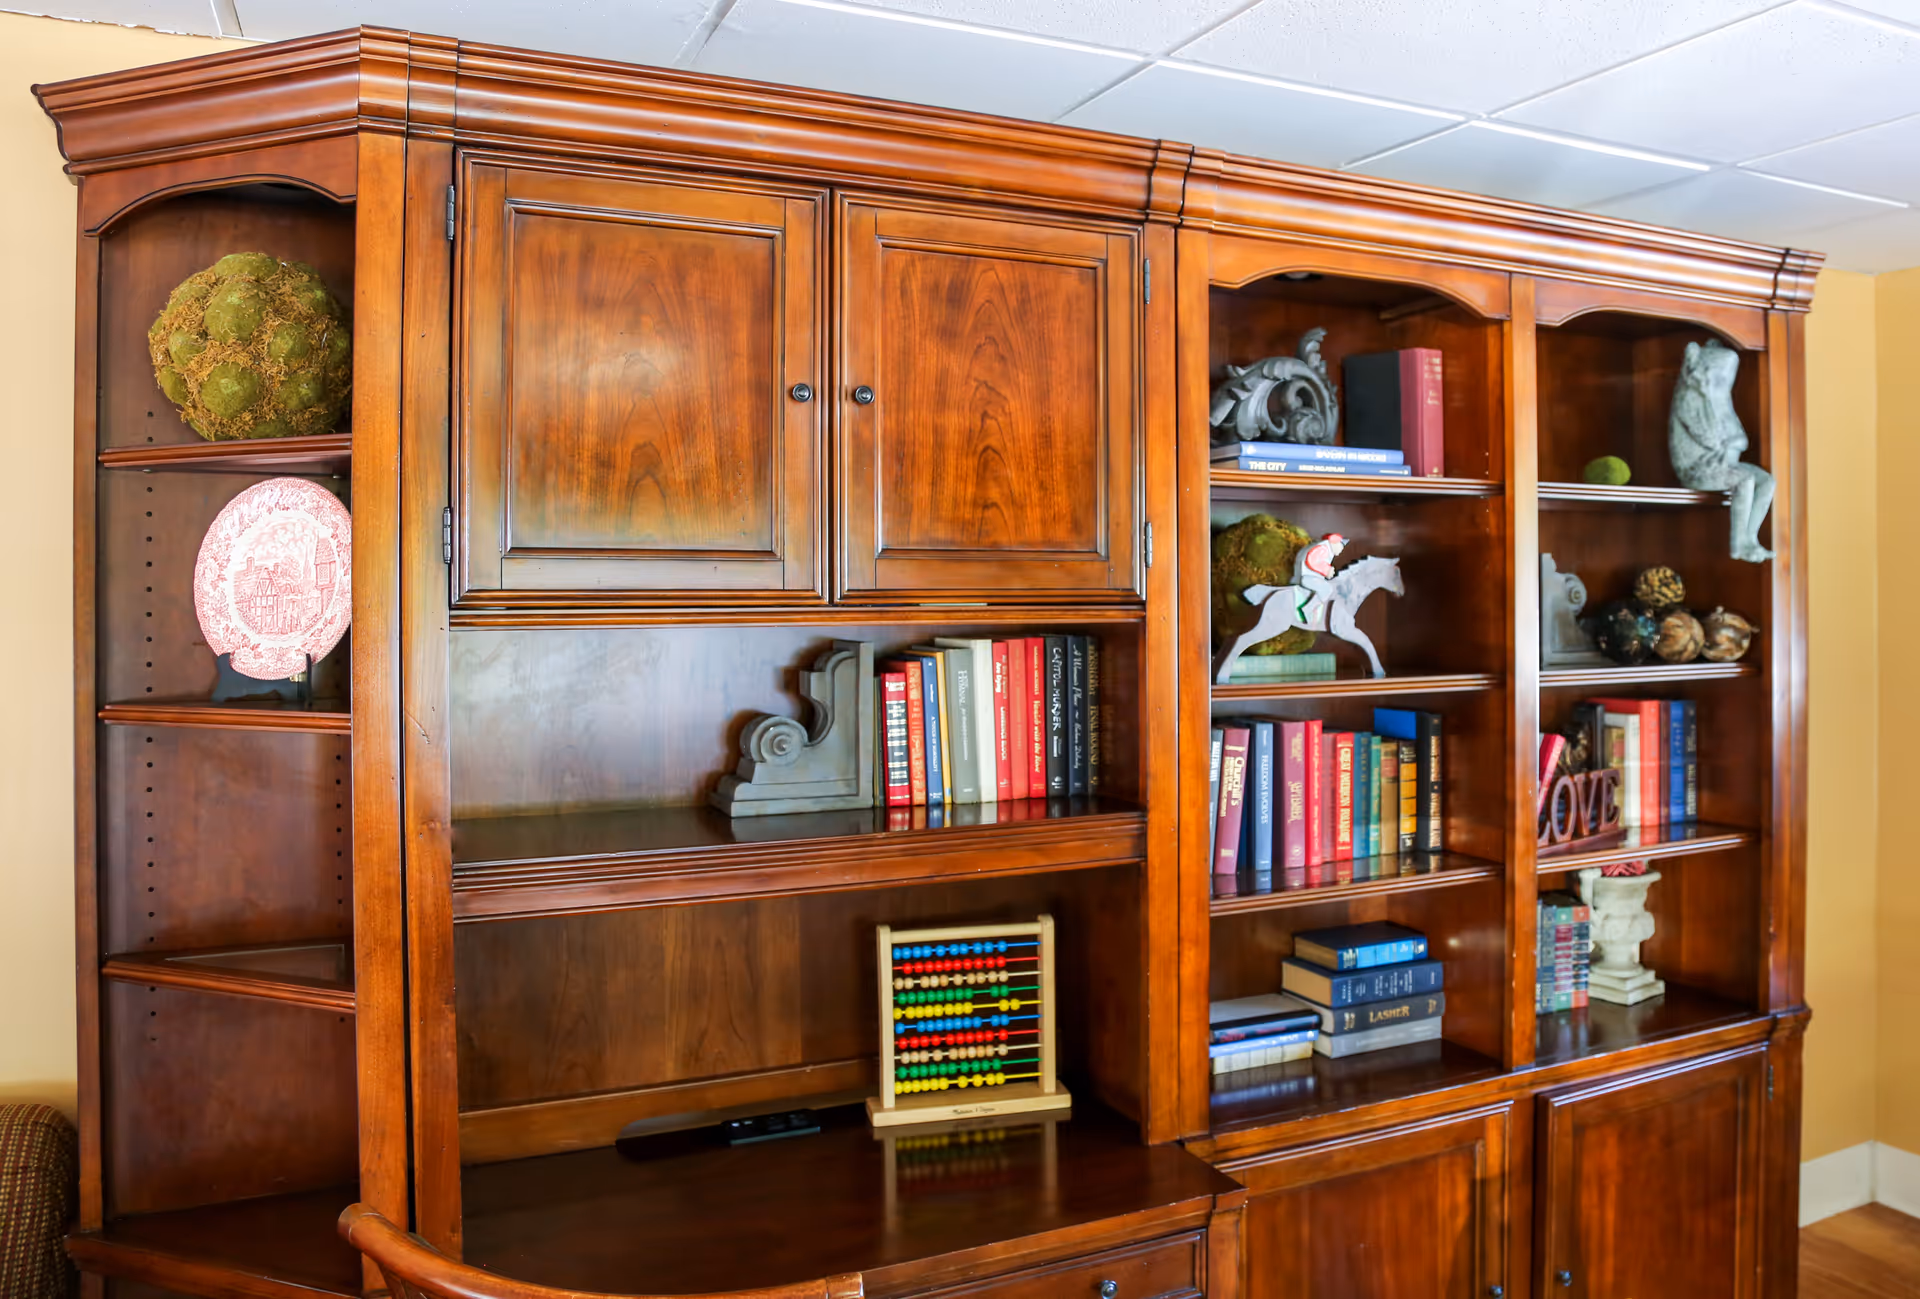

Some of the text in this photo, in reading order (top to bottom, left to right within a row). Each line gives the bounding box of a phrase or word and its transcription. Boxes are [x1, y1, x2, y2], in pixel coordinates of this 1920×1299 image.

[1248, 461, 1287, 472] THE CITY
[1051, 647, 1063, 687] CAPITOL
[958, 670, 968, 706] HYMNAL
[1051, 687, 1062, 731] MURDER
[1034, 725, 1042, 742] with
[1034, 742, 1042, 755] the
[1090, 705, 1099, 765] FINAL ROUND
[1230, 757, 1245, 806] Churchill's
[1260, 755, 1269, 791] FREEDOM
[1260, 791, 1269, 825] EVOLVES
[1287, 781, 1304, 824] SEPTEMBER
[1339, 748, 1352, 843] GREAT AMERICAN FOLKLORE
[1369, 1006, 1410, 1023] LASHER
